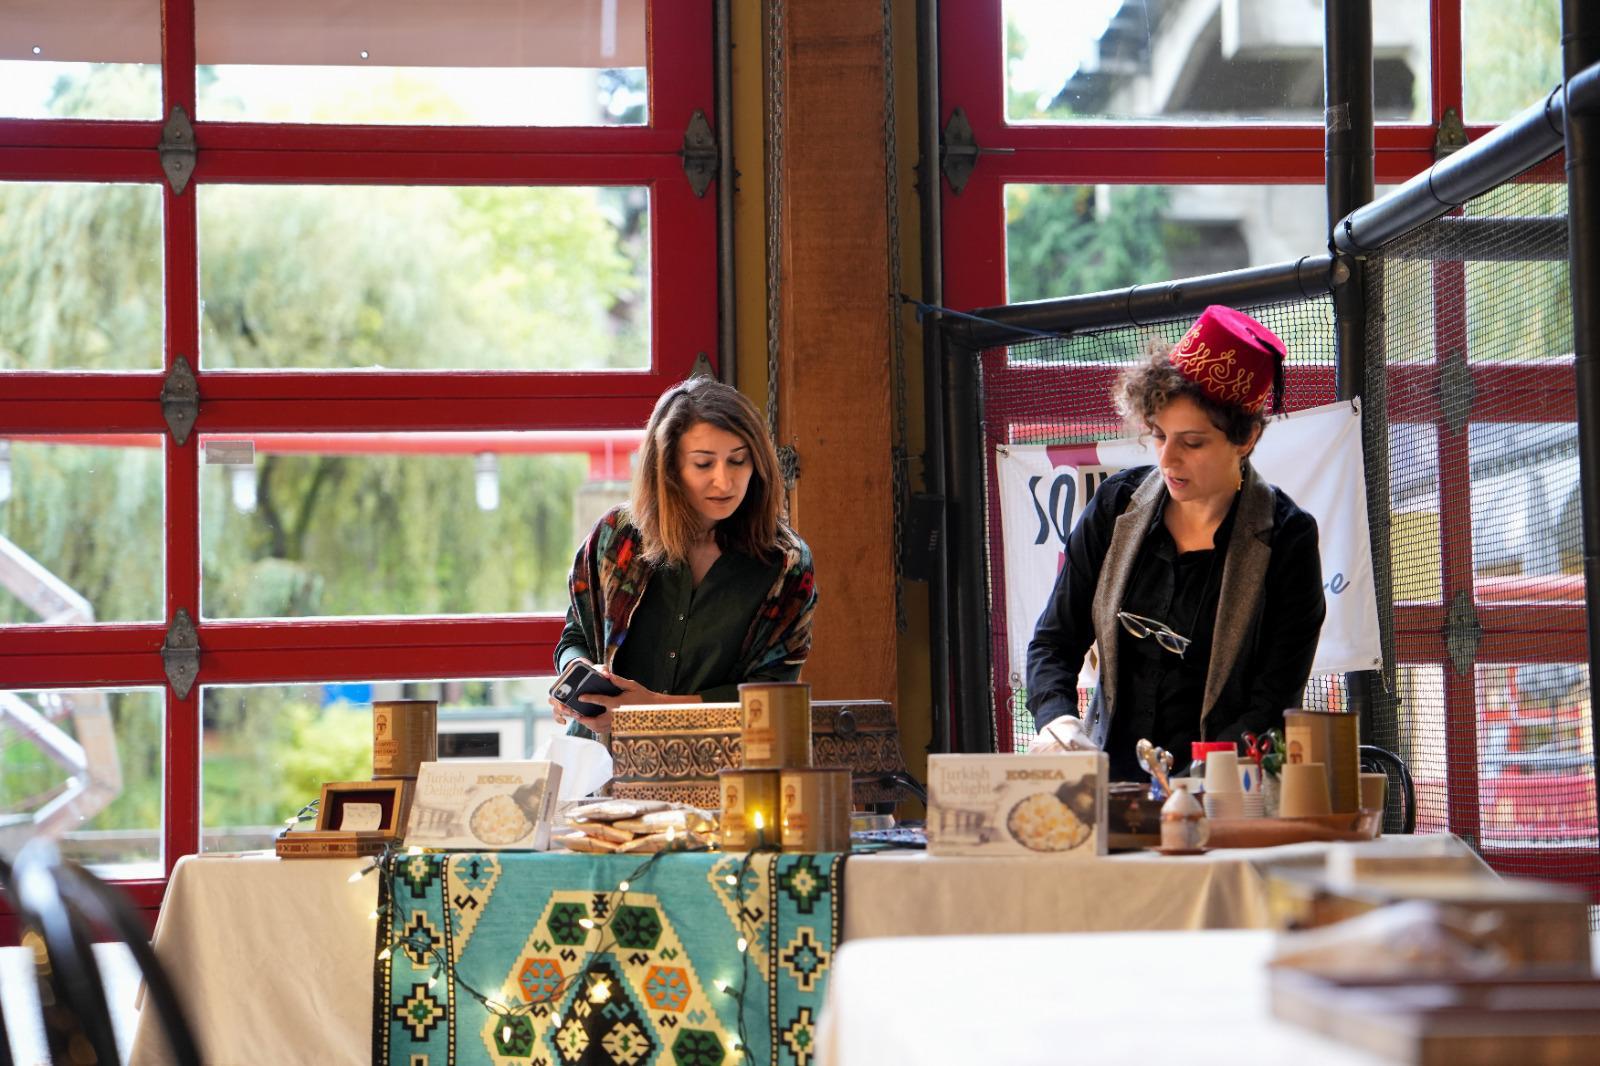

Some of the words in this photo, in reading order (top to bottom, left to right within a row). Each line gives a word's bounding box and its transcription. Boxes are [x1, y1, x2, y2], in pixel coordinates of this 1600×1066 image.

[940, 765, 990, 780] Turkish
[1005, 769, 1065, 781] KOSKA
[476, 775, 524, 785] KOSKA
[940, 781, 991, 797] Delight
